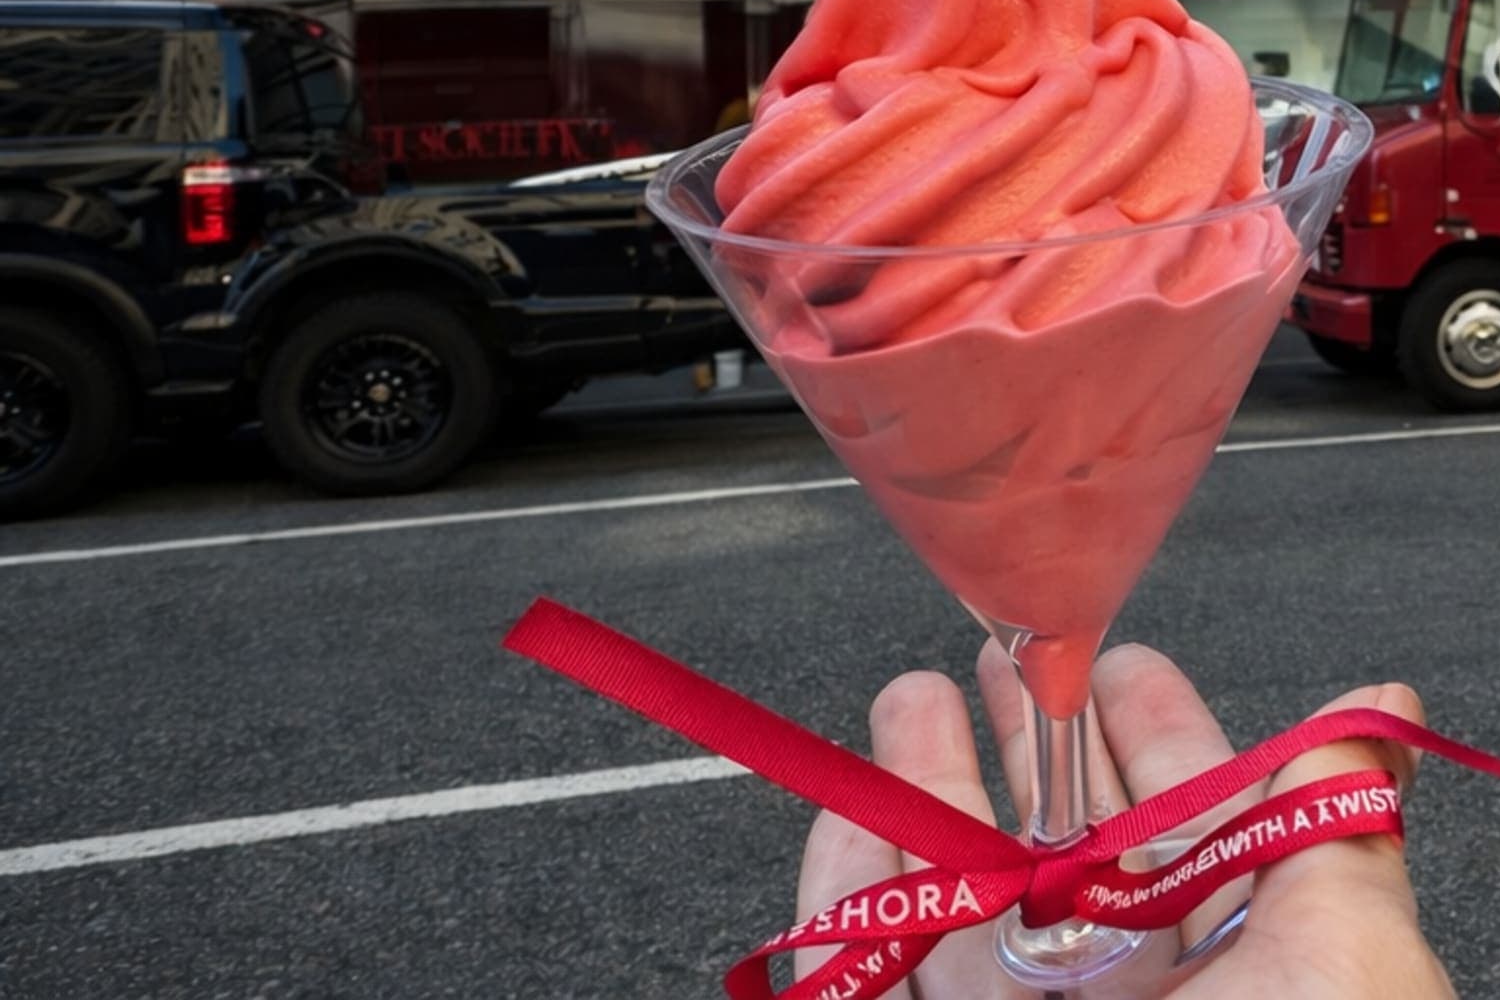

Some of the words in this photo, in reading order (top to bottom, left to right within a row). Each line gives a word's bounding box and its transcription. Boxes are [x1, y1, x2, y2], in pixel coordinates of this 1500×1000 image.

[1218, 815, 1287, 861] WITH
[1293, 808, 1313, 833] A
[1311, 788, 1397, 826] TWIST
